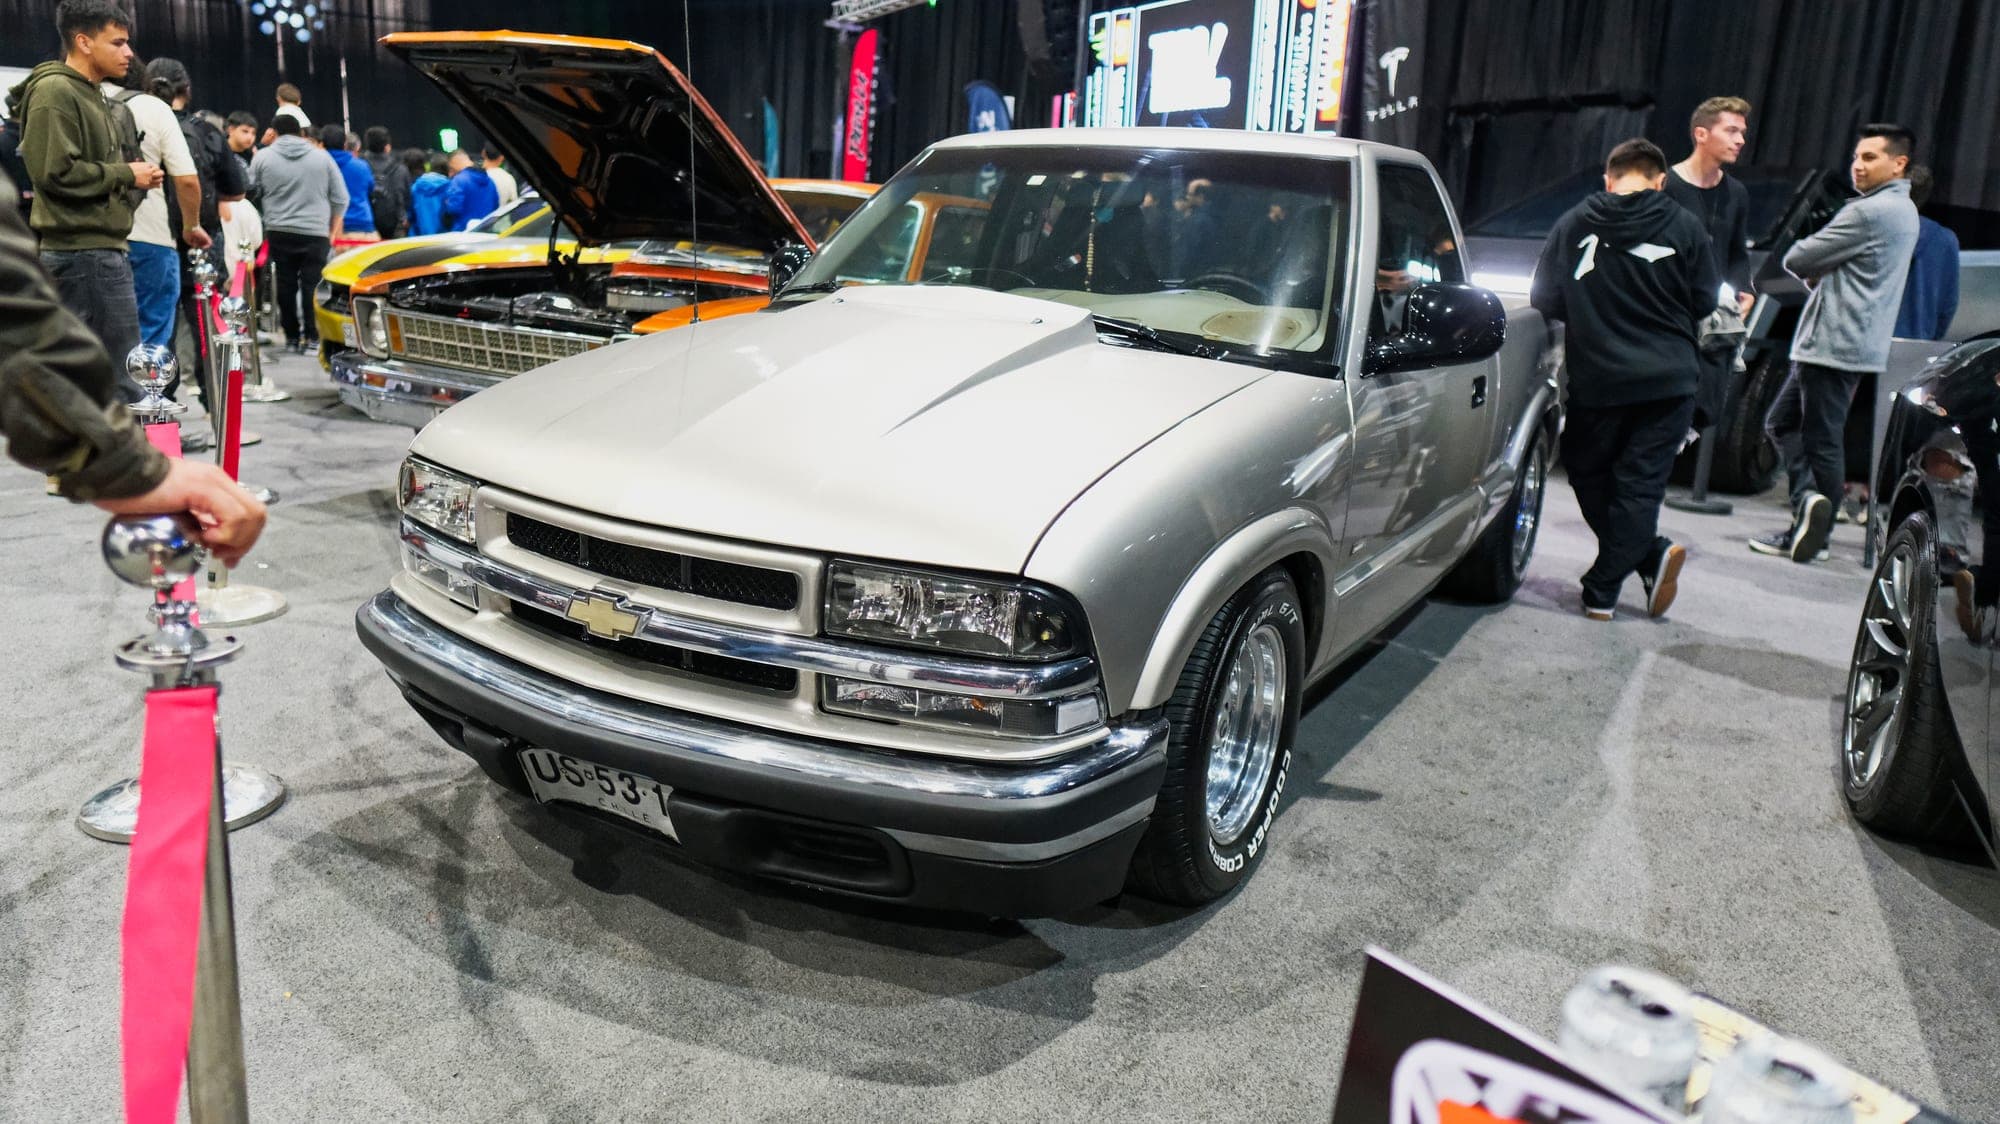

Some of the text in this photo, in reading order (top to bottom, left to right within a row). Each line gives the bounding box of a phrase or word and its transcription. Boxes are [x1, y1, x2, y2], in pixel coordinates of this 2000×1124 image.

[1366, 95, 1418, 122] TESLA
[1279, 602, 1298, 625] G/T
[598, 797, 650, 823] CHILE
[1209, 749, 1292, 873] COOPER COBRA
